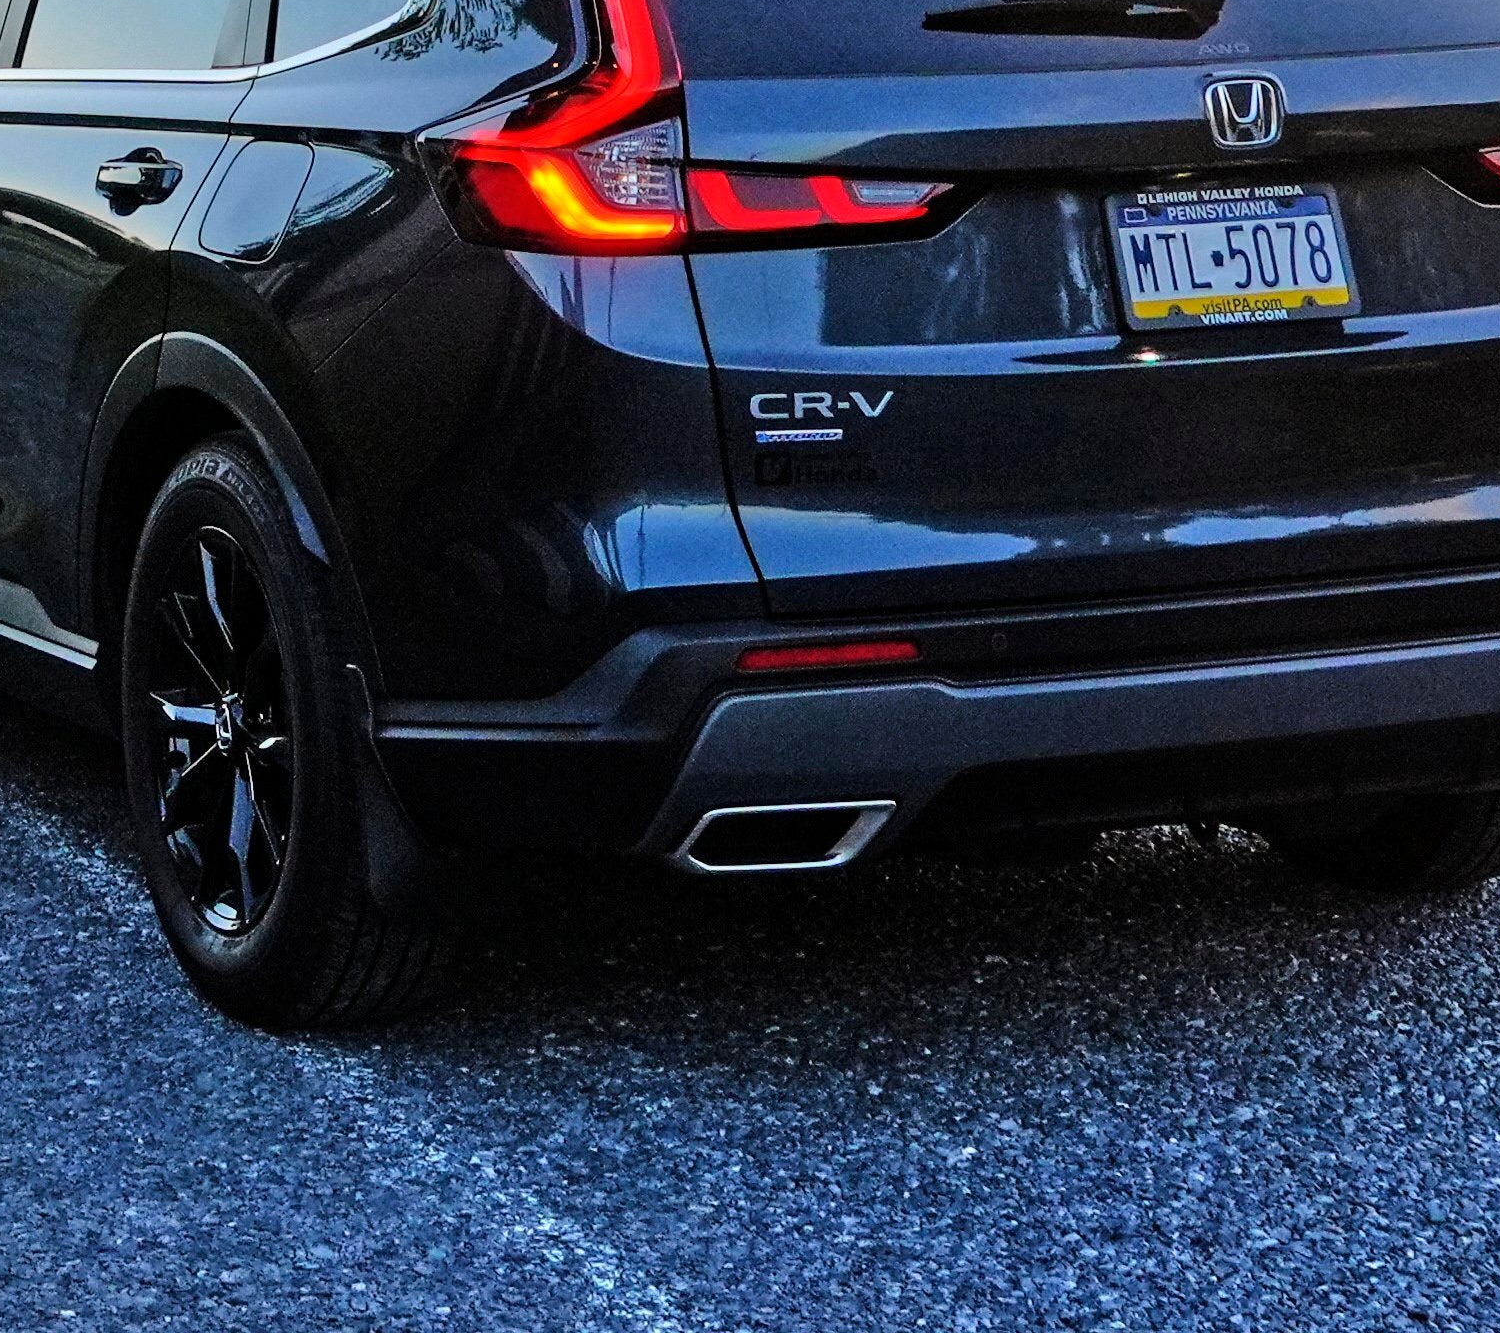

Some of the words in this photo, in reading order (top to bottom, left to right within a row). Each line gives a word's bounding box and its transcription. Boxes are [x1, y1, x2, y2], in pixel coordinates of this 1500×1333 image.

[1148, 190, 1198, 205] LEHIGH
[1200, 188, 1251, 202] VALLEY
[1253, 184, 1304, 198] HONDA
[1166, 200, 1279, 222] PENNSYLVANIA
[1202, 295, 1283, 314] visitPA.com
[1200, 308, 1289, 325] VINART.COM
[750, 391, 894, 419] CR-V
